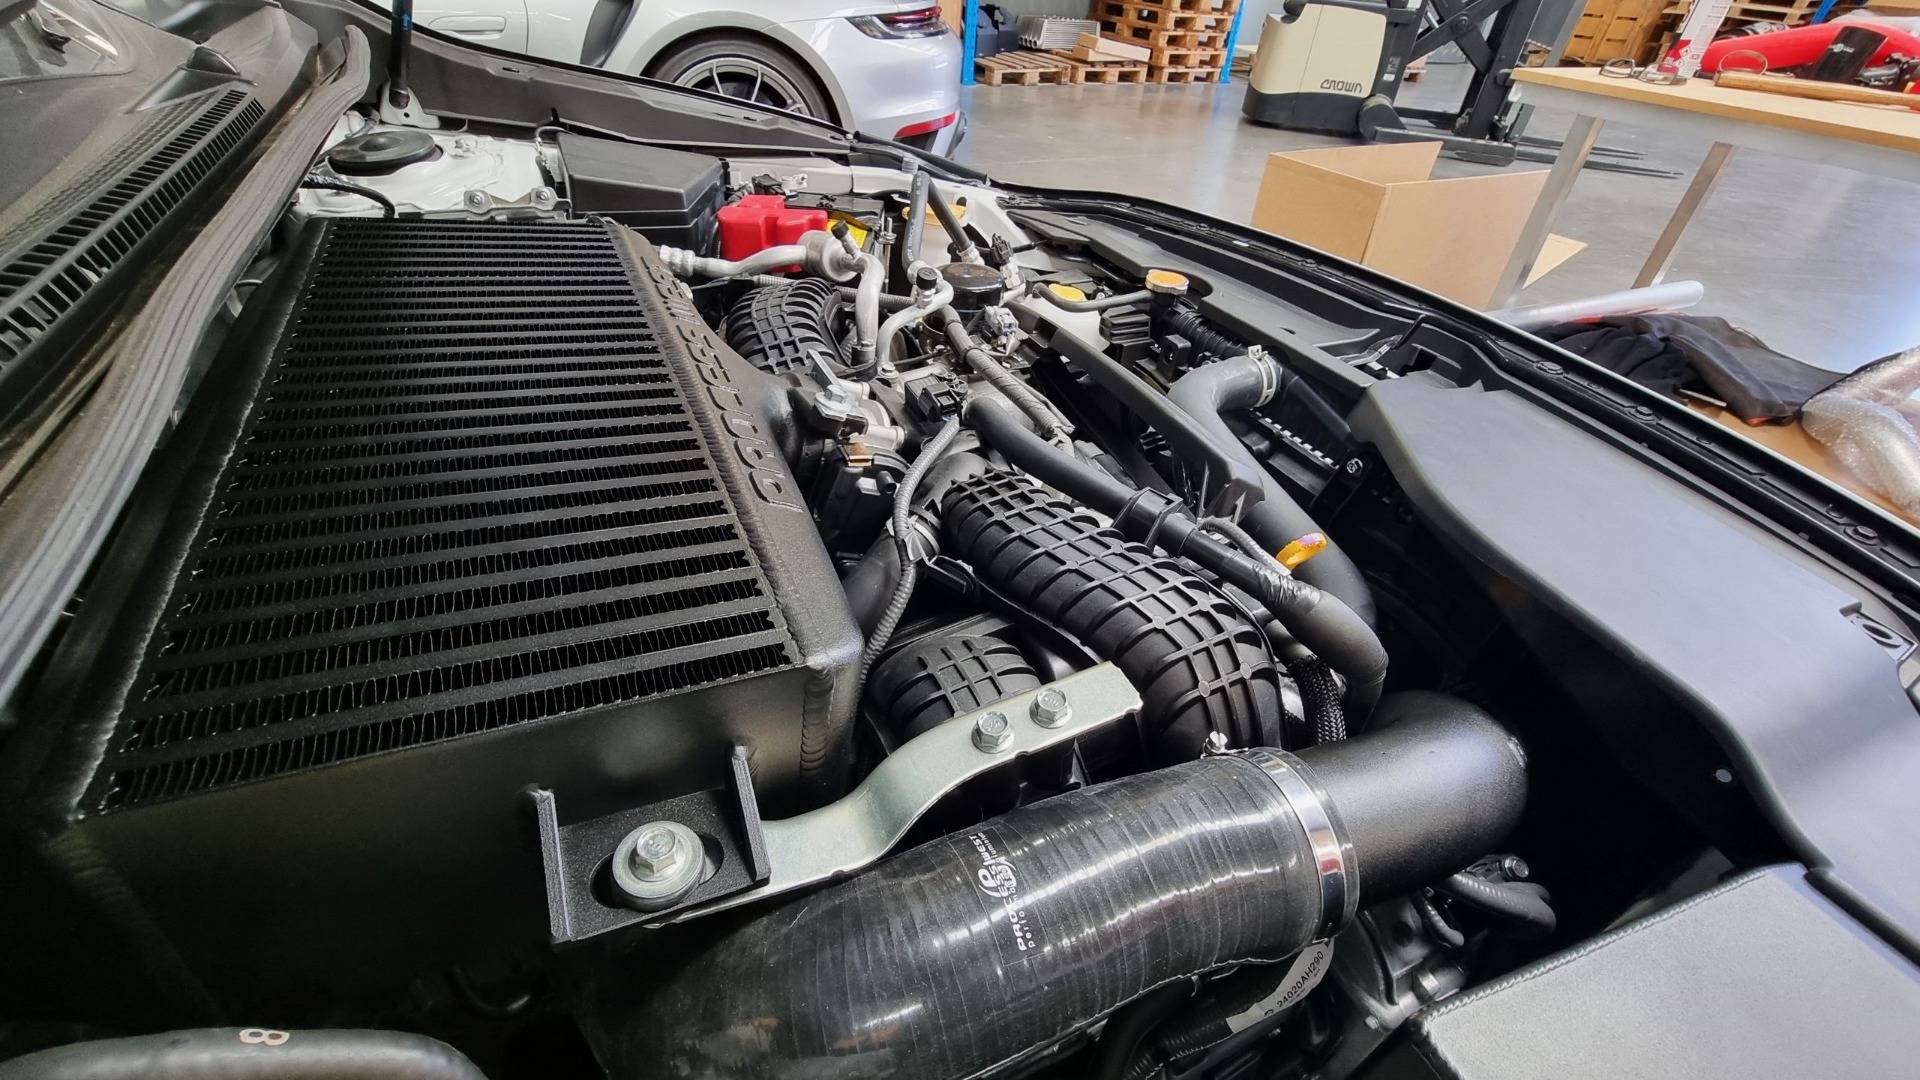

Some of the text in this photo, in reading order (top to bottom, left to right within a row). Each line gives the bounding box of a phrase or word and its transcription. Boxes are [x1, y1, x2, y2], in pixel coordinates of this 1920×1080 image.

[1321, 79, 1362, 93] CROWN
[969, 834, 991, 861] WEST
[1276, 950, 1324, 1008] 24020AH290
